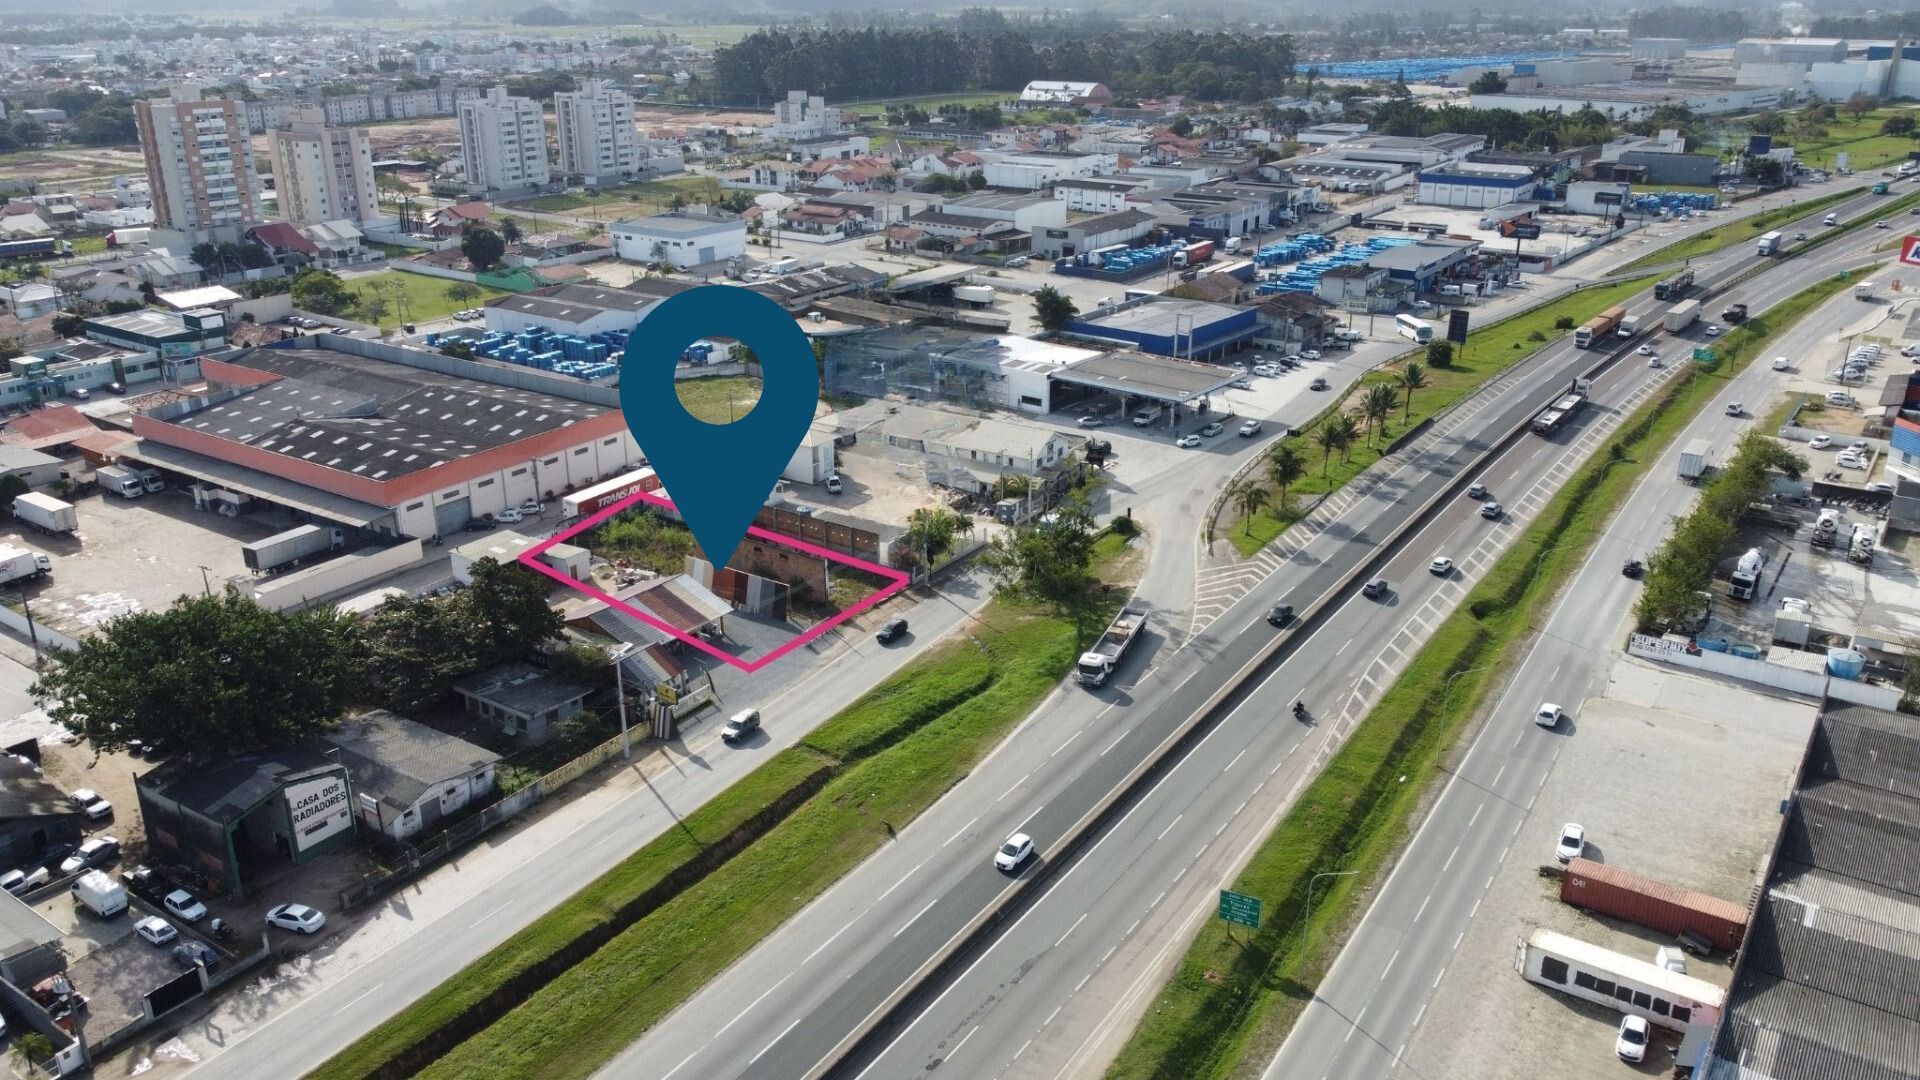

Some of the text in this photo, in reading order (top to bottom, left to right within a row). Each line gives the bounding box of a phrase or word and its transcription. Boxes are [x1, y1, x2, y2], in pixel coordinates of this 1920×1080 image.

[598, 488, 628, 508] TRANS
[1634, 635, 1687, 655] SUPERMIX
[293, 791, 347, 825] RADIADORES
[297, 783, 340, 810] CASA DOS
